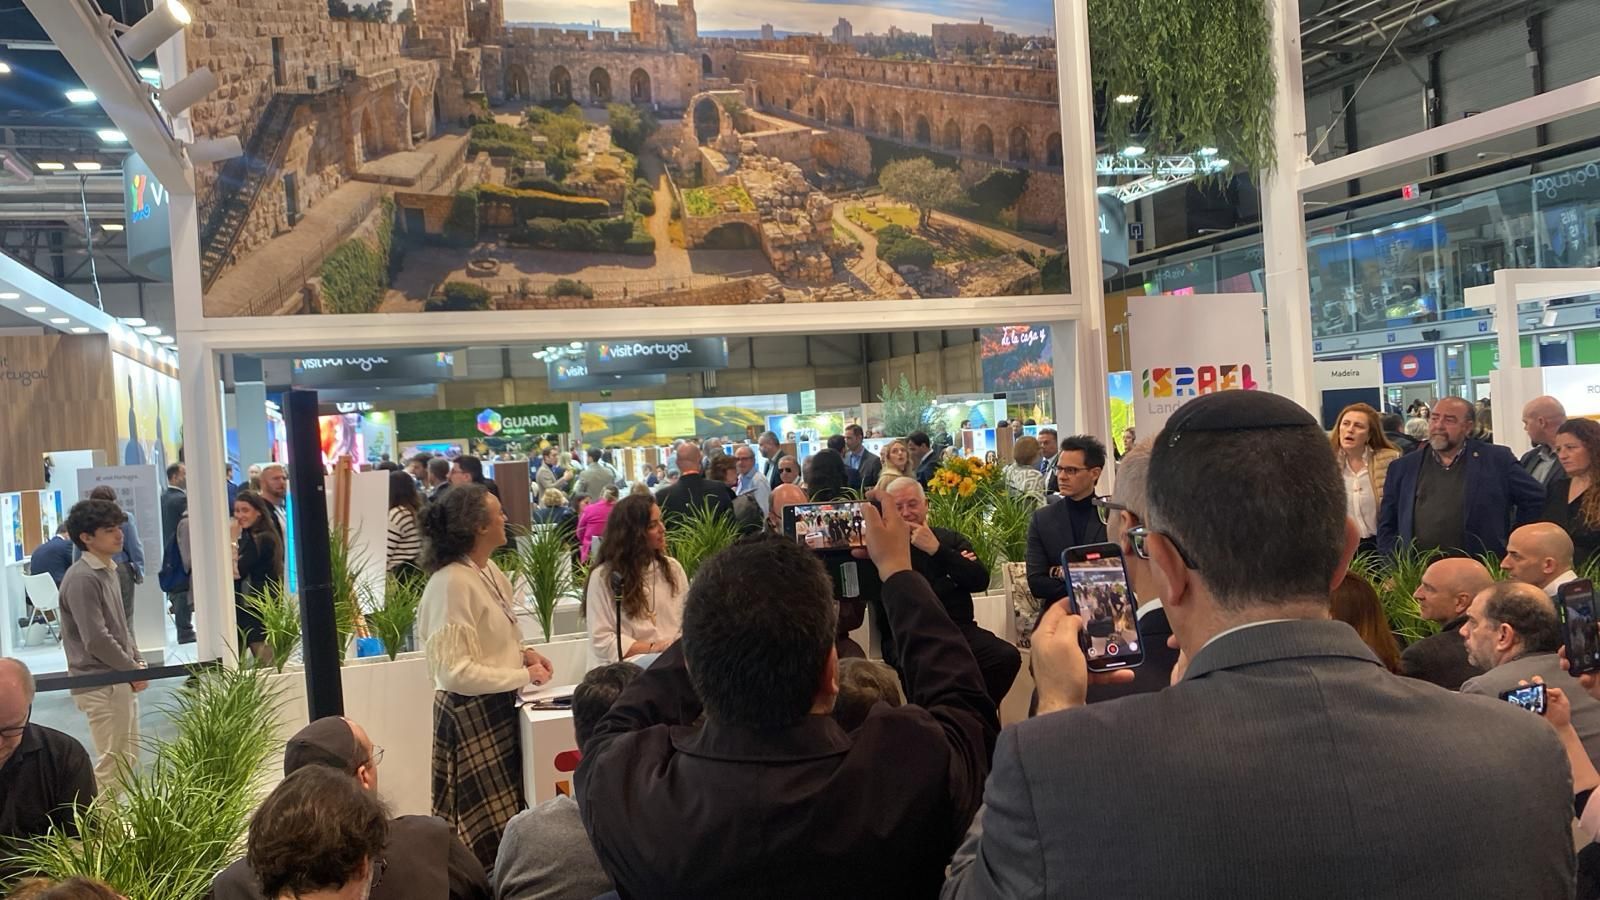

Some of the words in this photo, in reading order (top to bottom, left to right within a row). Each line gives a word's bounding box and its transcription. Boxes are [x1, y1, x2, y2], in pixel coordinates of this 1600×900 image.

[610, 345, 632, 358] visit
[633, 342, 692, 360] Portugal
[566, 365, 584, 377] visit
[1331, 369, 1360, 377] Madeira
[502, 414, 558, 428] GUARDA
